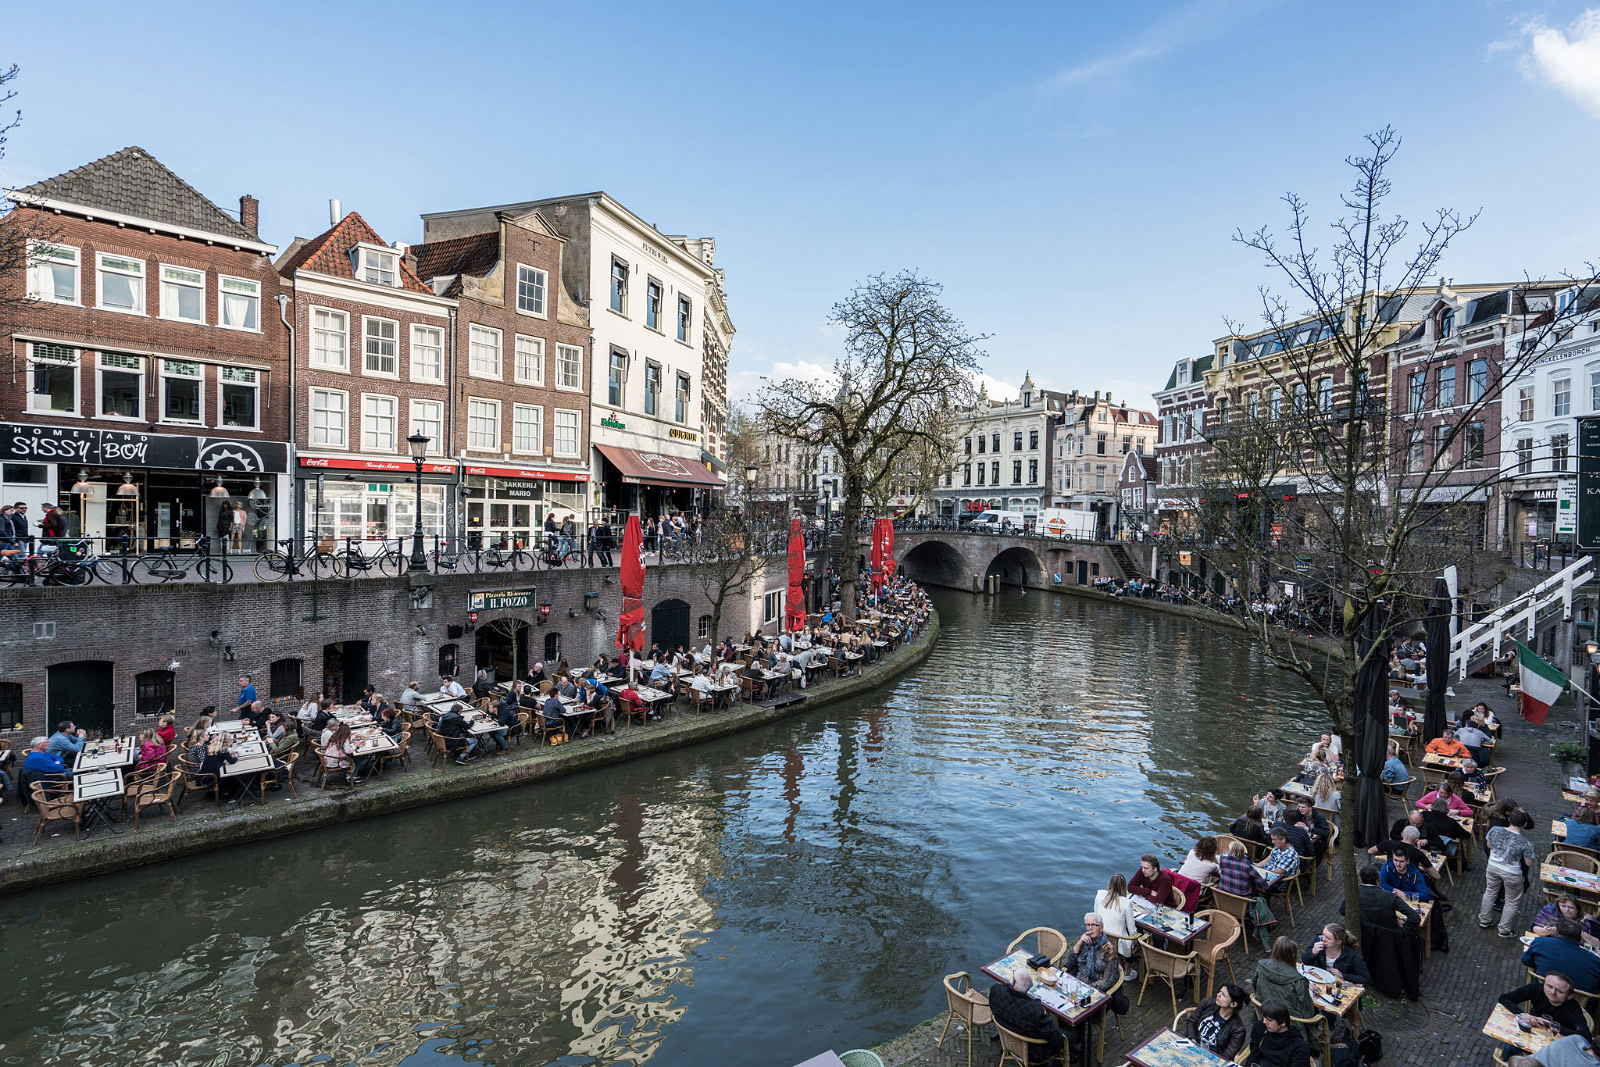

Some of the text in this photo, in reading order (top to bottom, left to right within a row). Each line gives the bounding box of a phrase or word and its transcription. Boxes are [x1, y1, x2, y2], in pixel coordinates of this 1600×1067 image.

[13, 426, 148, 442] HOMELAND
[669, 428, 697, 442] QUIGNON
[10, 436, 149, 464] SISSY-BOY
[306, 458, 329, 467] Coca-Cola
[509, 490, 532, 498] MARIO
[500, 596, 528, 608] POZZO
